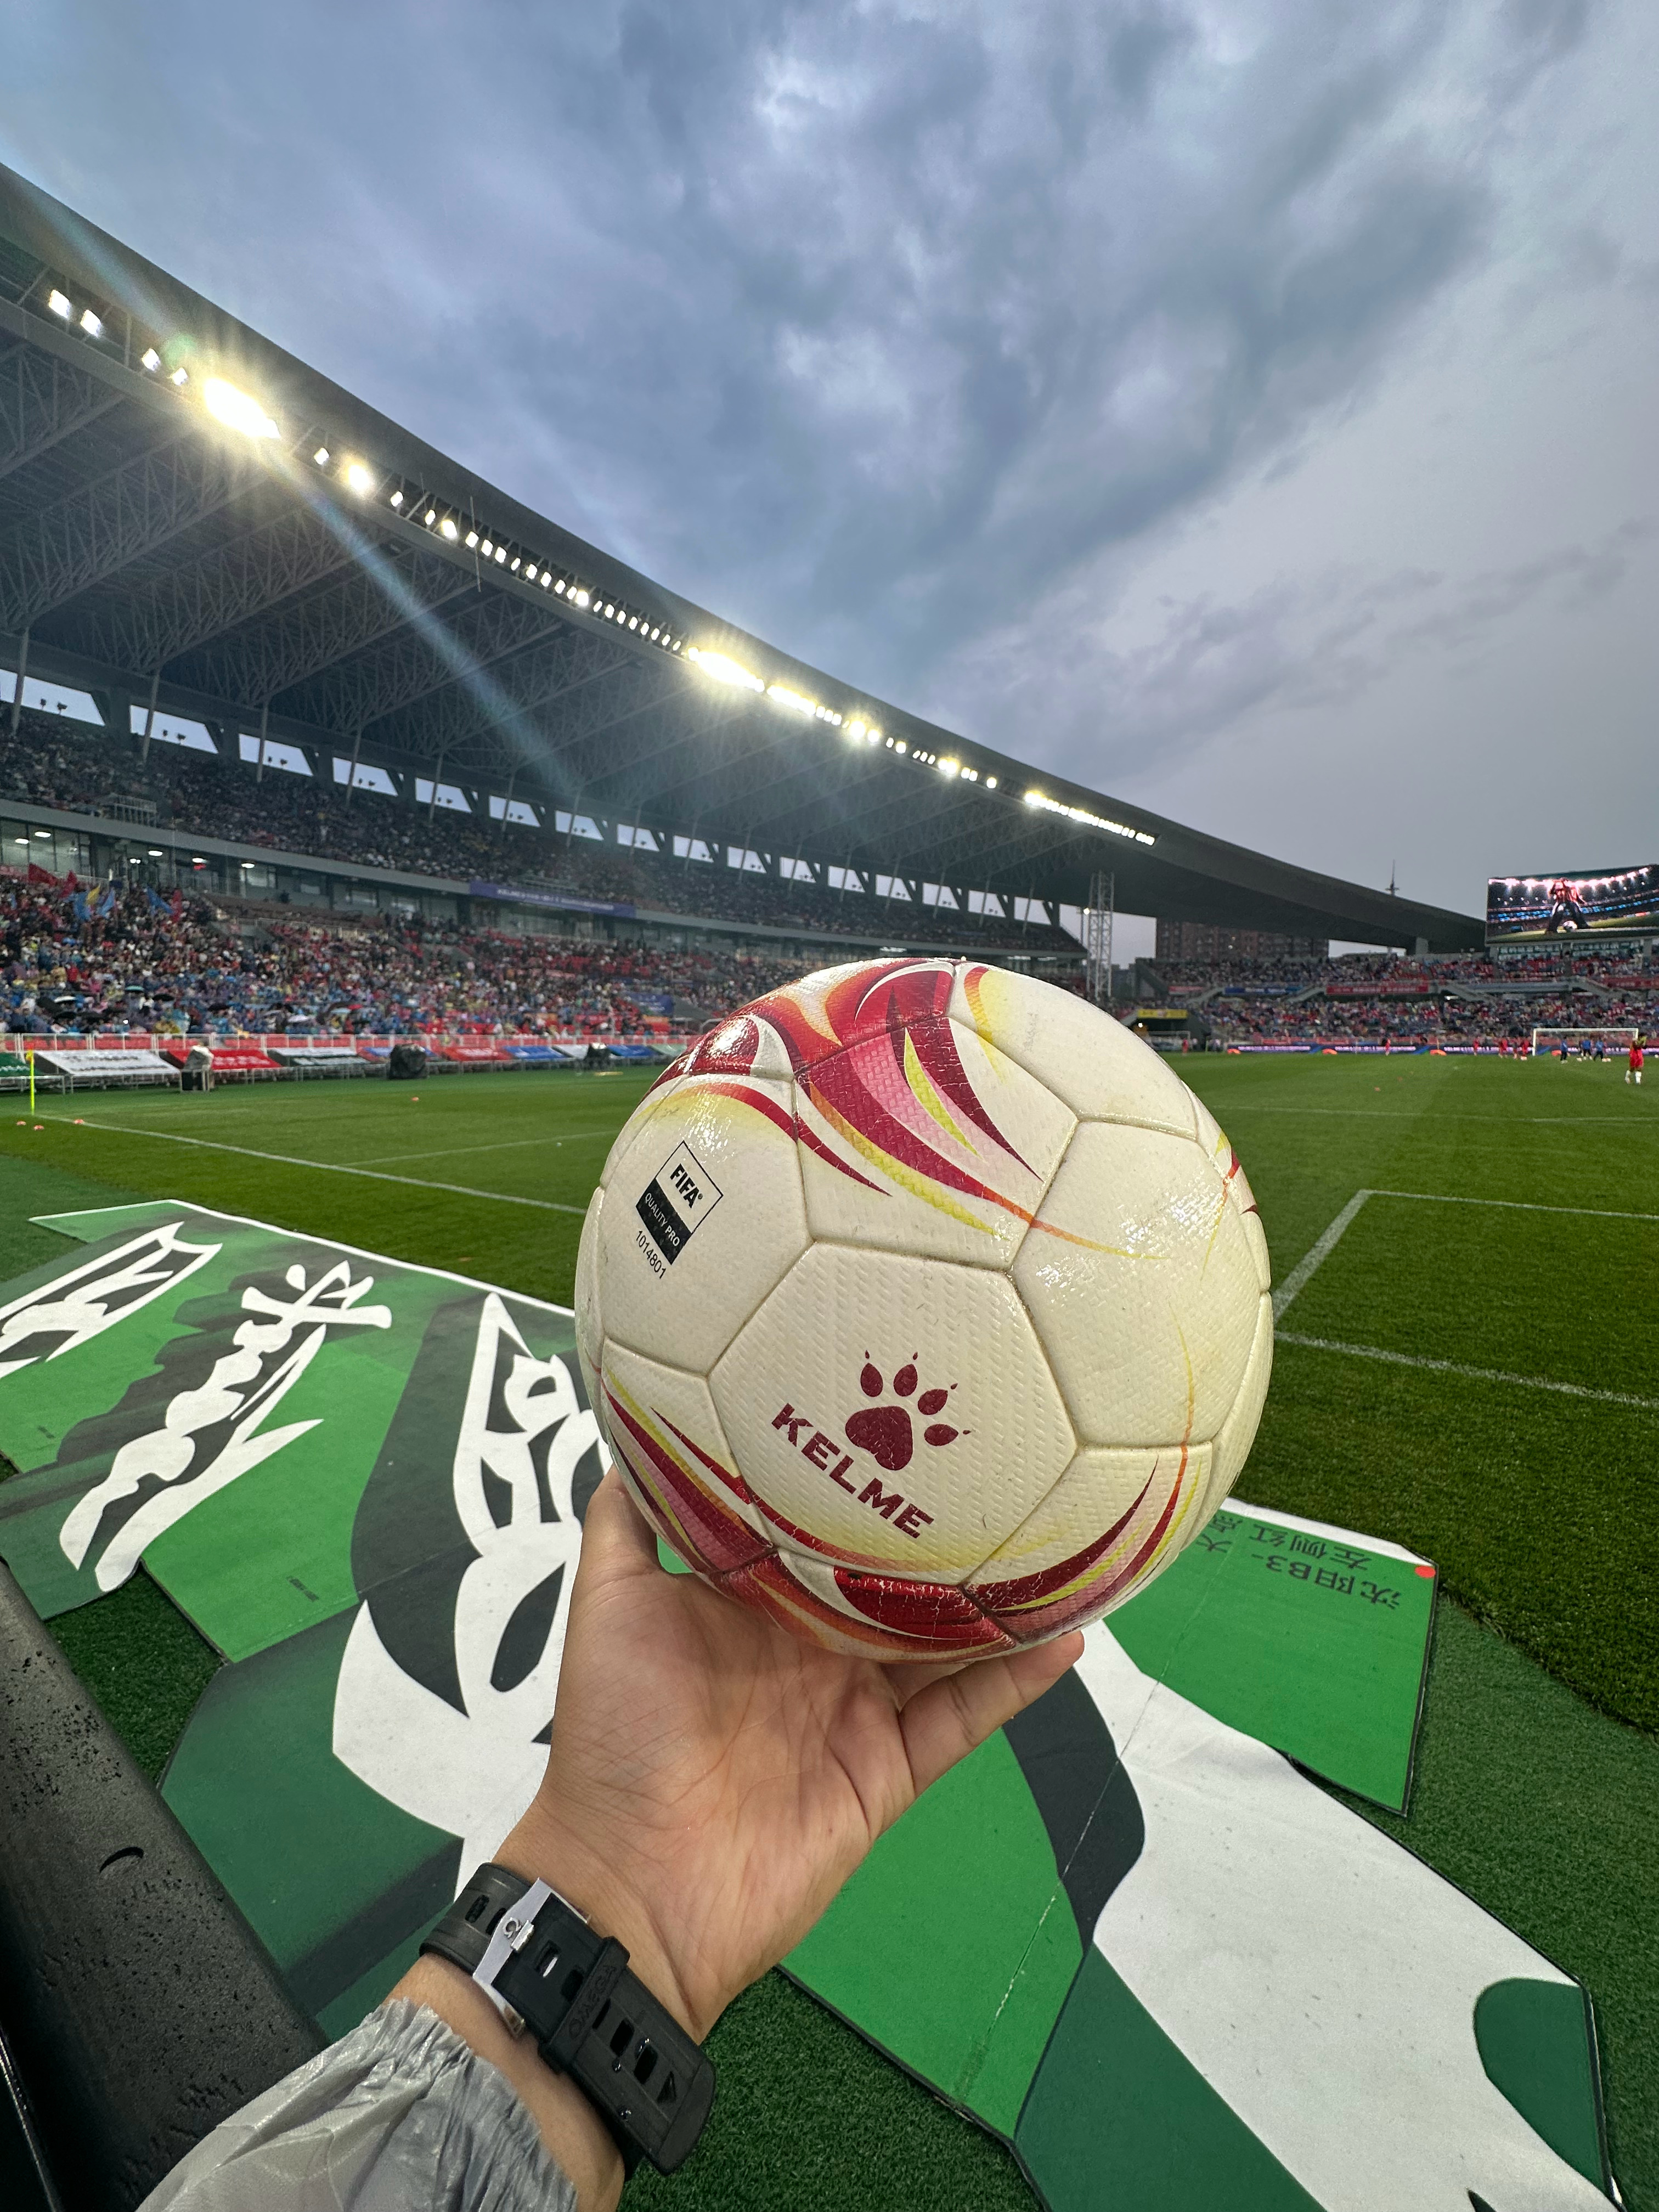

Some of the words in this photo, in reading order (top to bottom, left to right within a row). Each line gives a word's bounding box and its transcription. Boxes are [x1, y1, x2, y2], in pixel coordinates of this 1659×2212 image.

[670, 1163, 699, 1208] FIFA
[645, 1193, 668, 1227] QUALITY
[664, 1225, 680, 1246] PRO
[636, 1230, 667, 1279] 1014801
[771, 1402, 934, 1538] KELME
[568, 1965, 618, 2039] OMEGA
